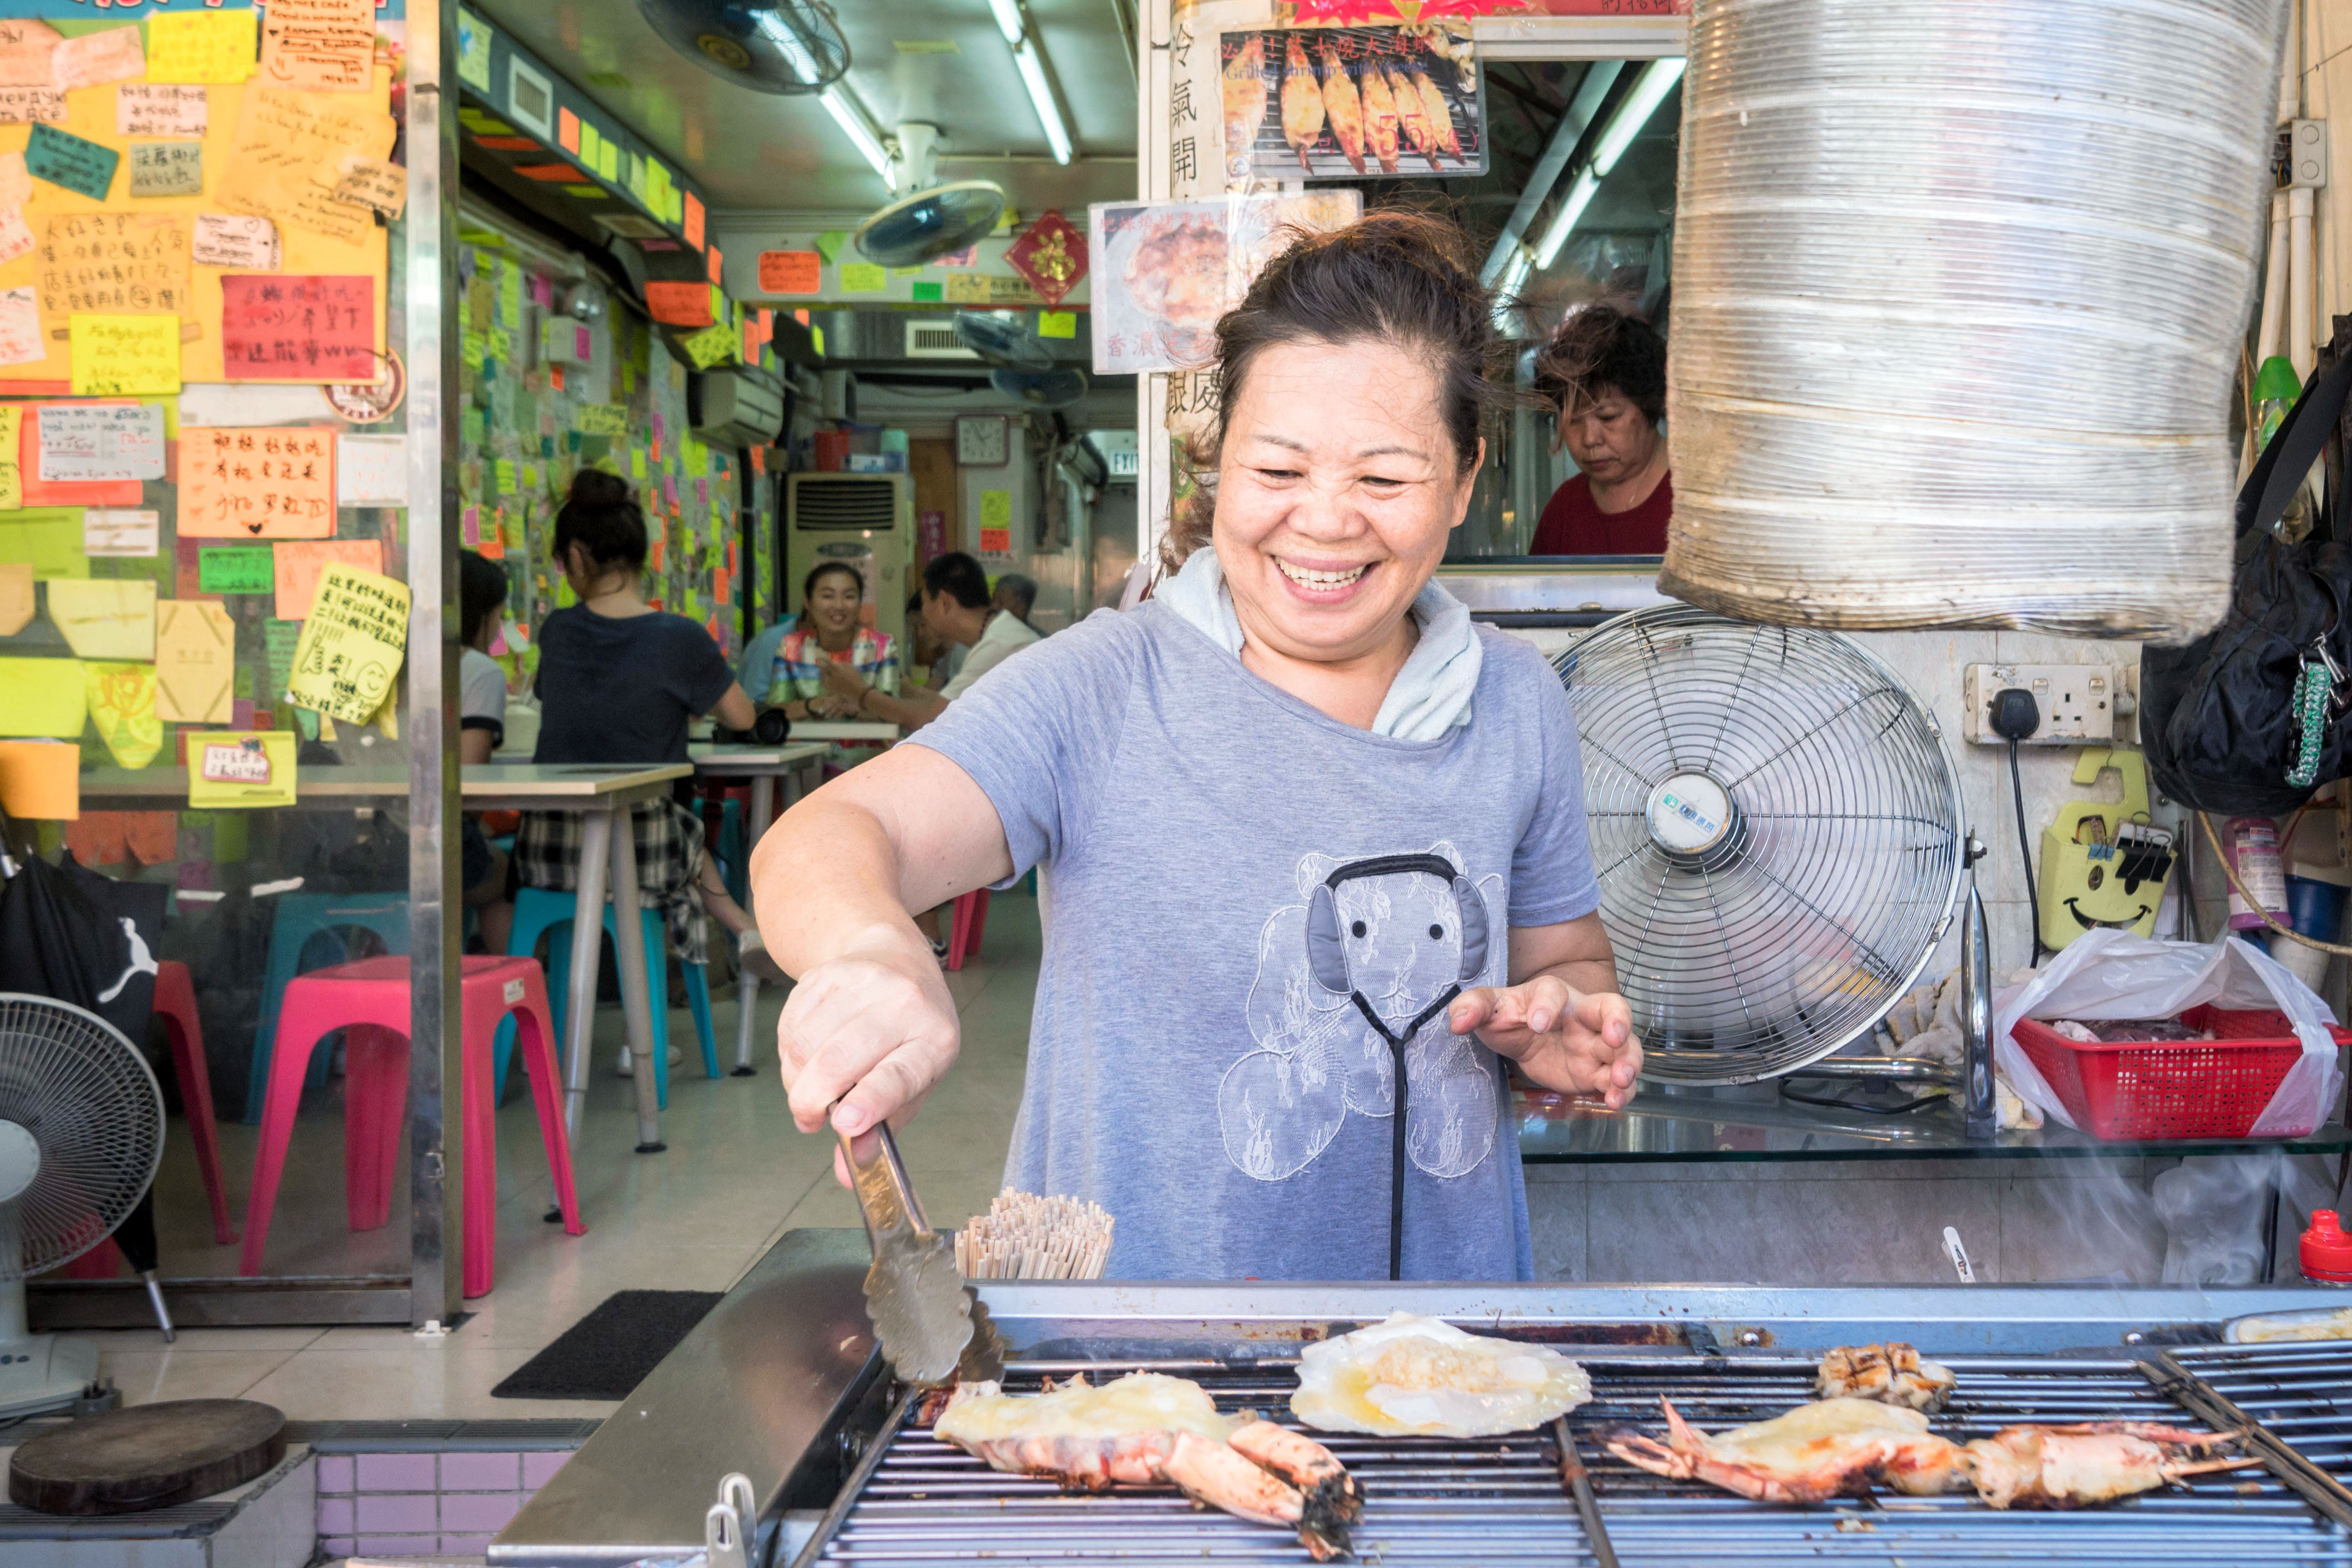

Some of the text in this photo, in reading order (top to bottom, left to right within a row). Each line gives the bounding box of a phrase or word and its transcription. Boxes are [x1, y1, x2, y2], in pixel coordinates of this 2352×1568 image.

[1226, 60, 1428, 82] Grilled shrimp with cheese
[1172, 24, 1197, 203] 冷氣開
[1027, 229, 1076, 281] 福
